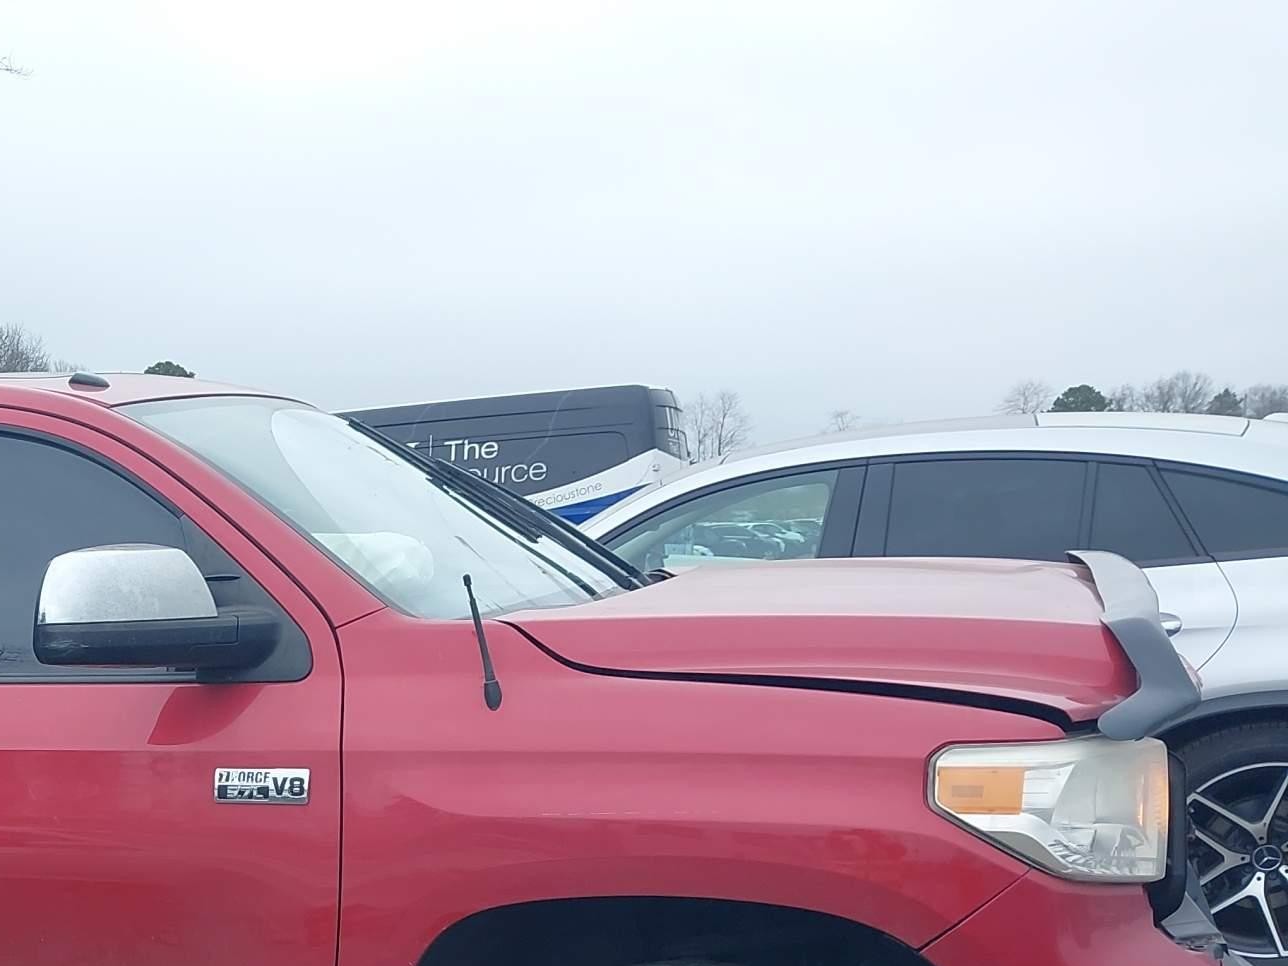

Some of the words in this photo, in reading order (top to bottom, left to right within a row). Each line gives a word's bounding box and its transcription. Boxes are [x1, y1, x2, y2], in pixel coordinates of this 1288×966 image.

[444, 439, 498, 461] The
[469, 462, 547, 484] urce
[272, 776, 306, 798] V8
